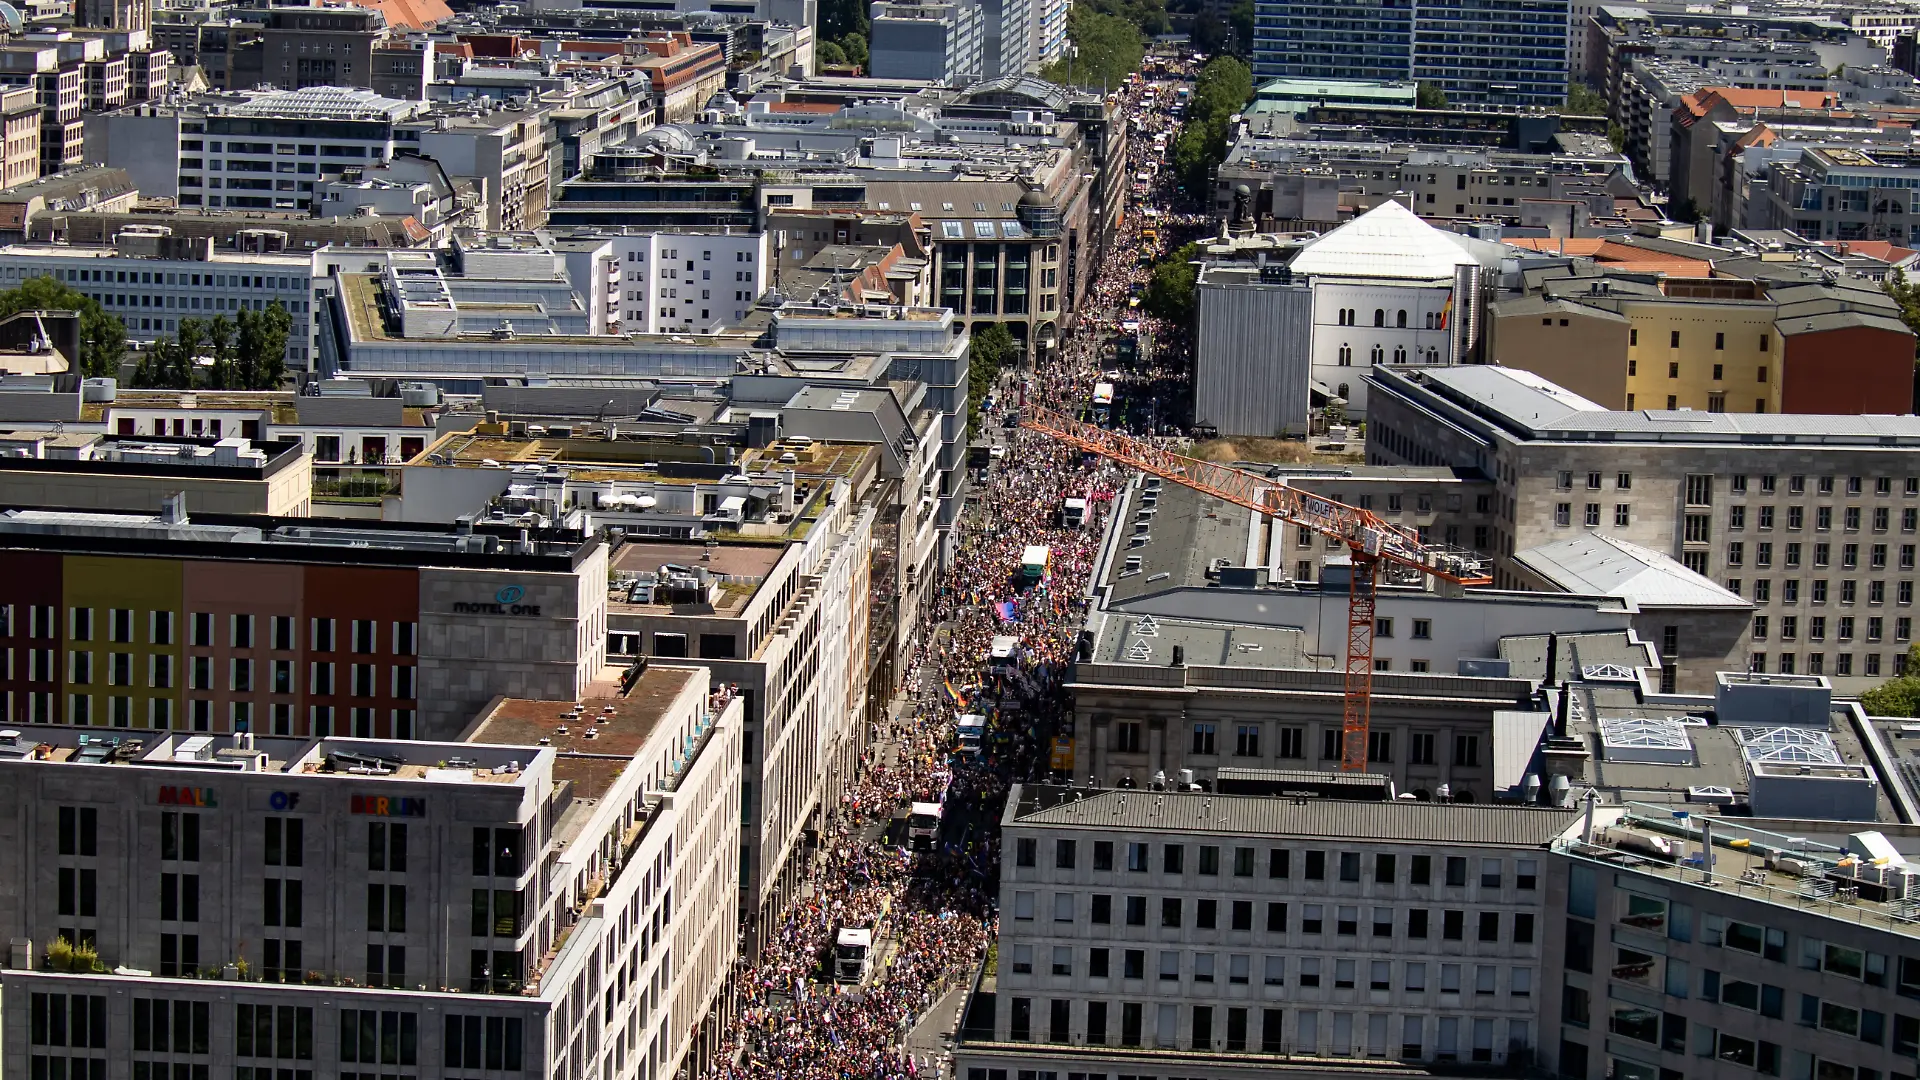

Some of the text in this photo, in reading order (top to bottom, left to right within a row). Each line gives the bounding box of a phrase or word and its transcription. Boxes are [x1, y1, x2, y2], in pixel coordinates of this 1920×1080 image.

[1068, 249, 1076, 293] HOTEL
[1306, 498, 1334, 516] WOLFF
[453, 602, 541, 616] MOTEL ONE
[157, 785, 426, 818] MALL OF BERLIN
